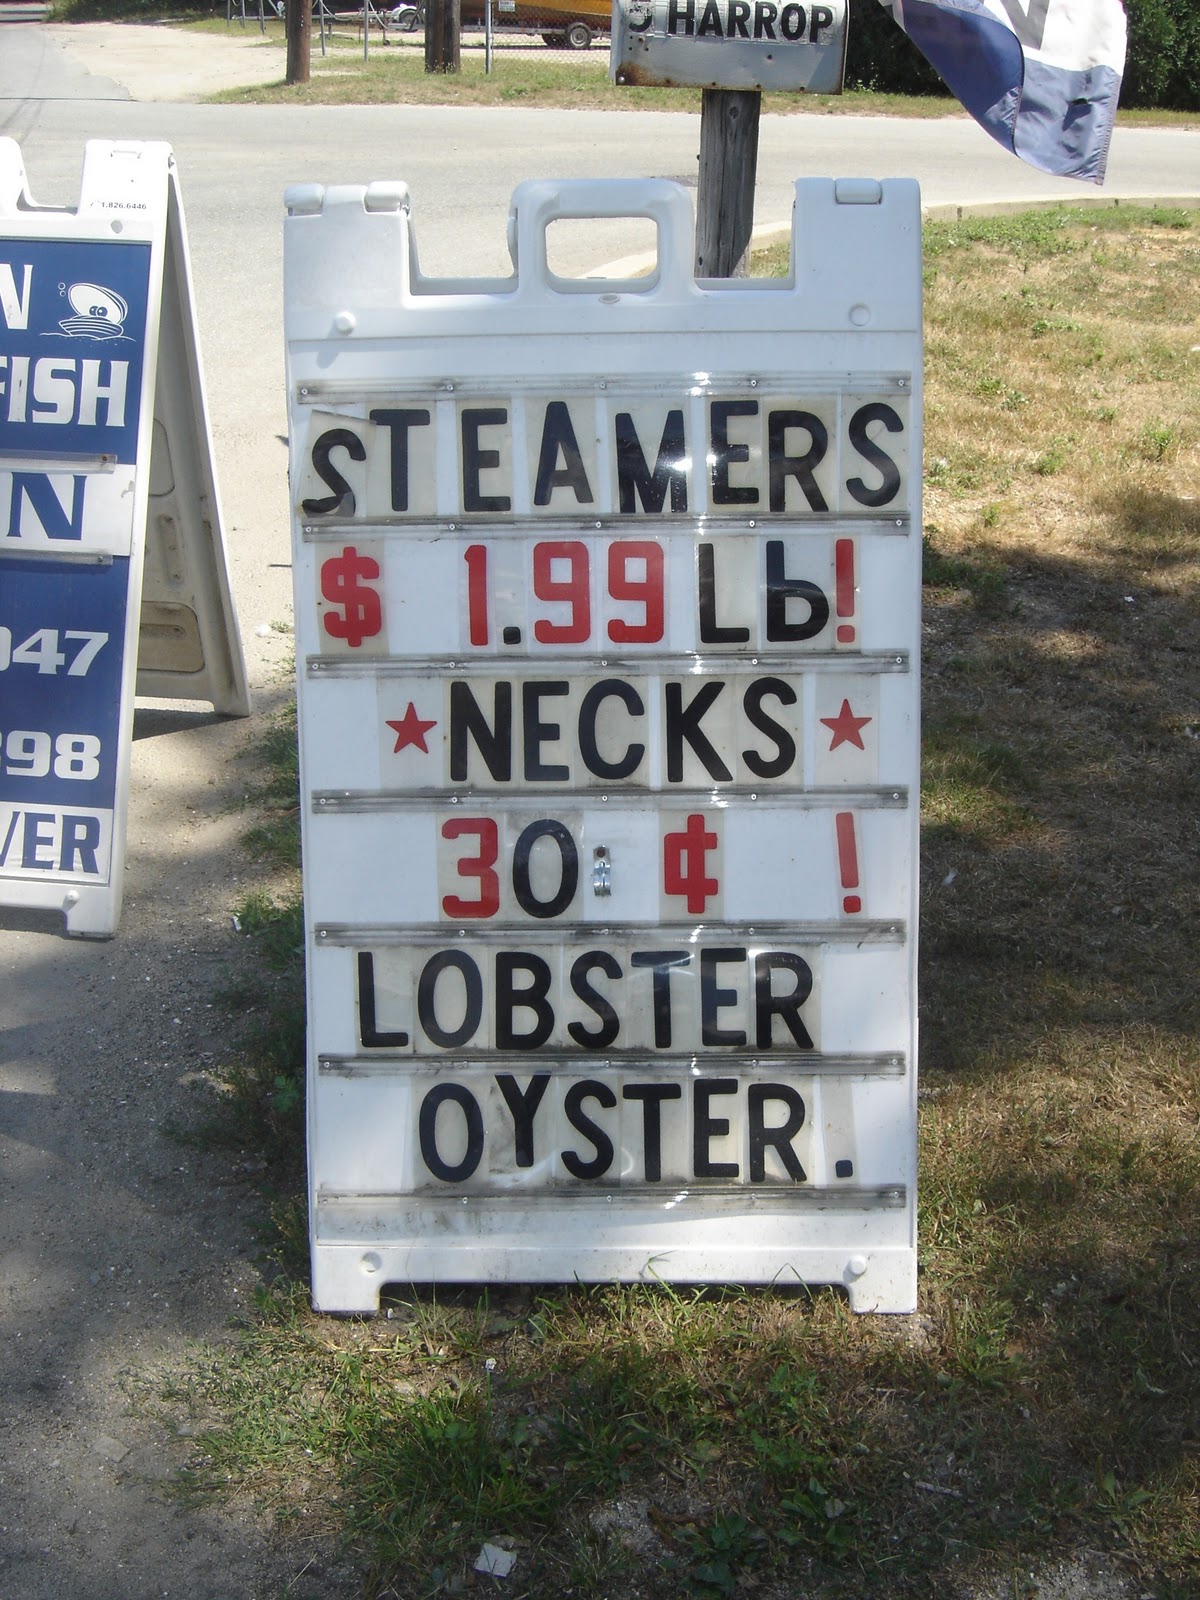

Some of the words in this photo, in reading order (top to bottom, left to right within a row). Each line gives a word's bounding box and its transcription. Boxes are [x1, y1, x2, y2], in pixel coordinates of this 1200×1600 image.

[667, 0, 834, 43] HARROP
[0, 355, 130, 427] ISH
[302, 400, 904, 517] STEAMERS
[0, 626, 109, 676] 47
[0, 730, 101, 780] 98
[449, 677, 798, 783] NECKS
[441, 817, 580, 919] 30
[357, 947, 814, 1050] LOBSTER
[418, 1073, 854, 1183] OYSTER.
